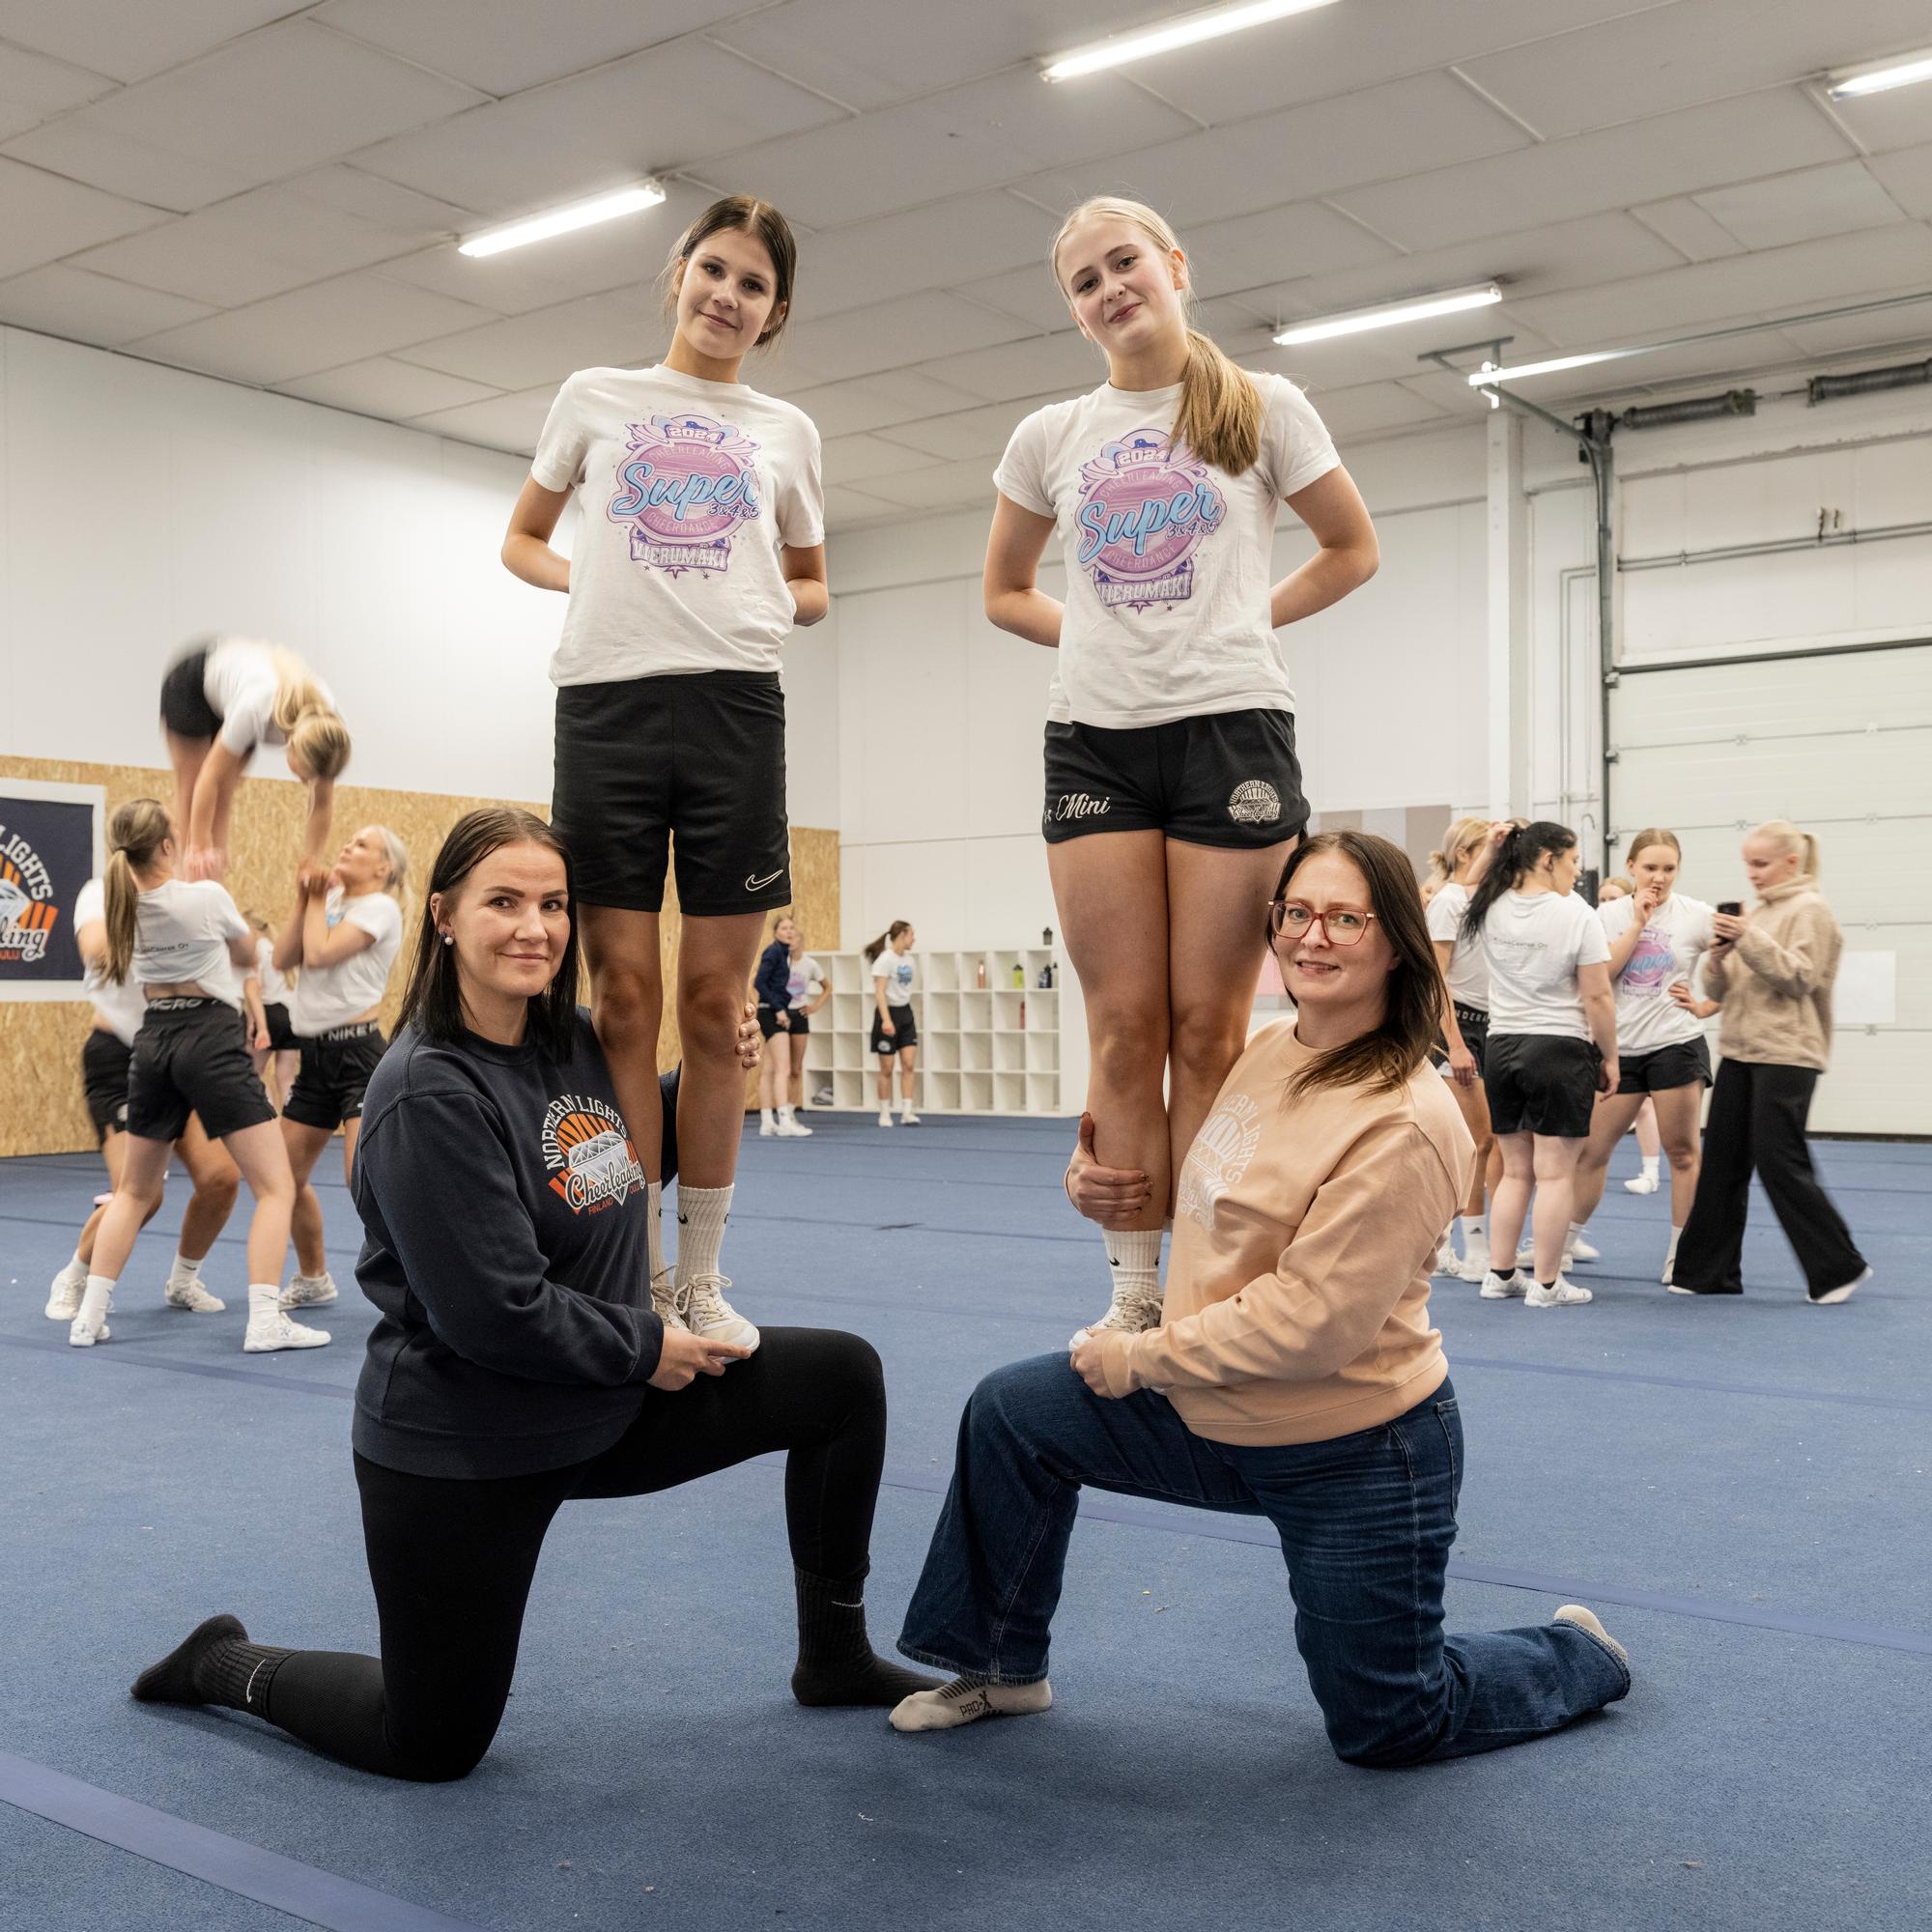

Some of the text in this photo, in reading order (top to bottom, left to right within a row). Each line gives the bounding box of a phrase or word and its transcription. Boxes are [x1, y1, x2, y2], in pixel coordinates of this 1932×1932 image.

[668, 427, 720, 443] 2024
[611, 462, 758, 521] Super
[1077, 482, 1220, 564] Super
[1056, 793, 1110, 821] Mini
[574, 1094, 627, 1139] LIGHTS
